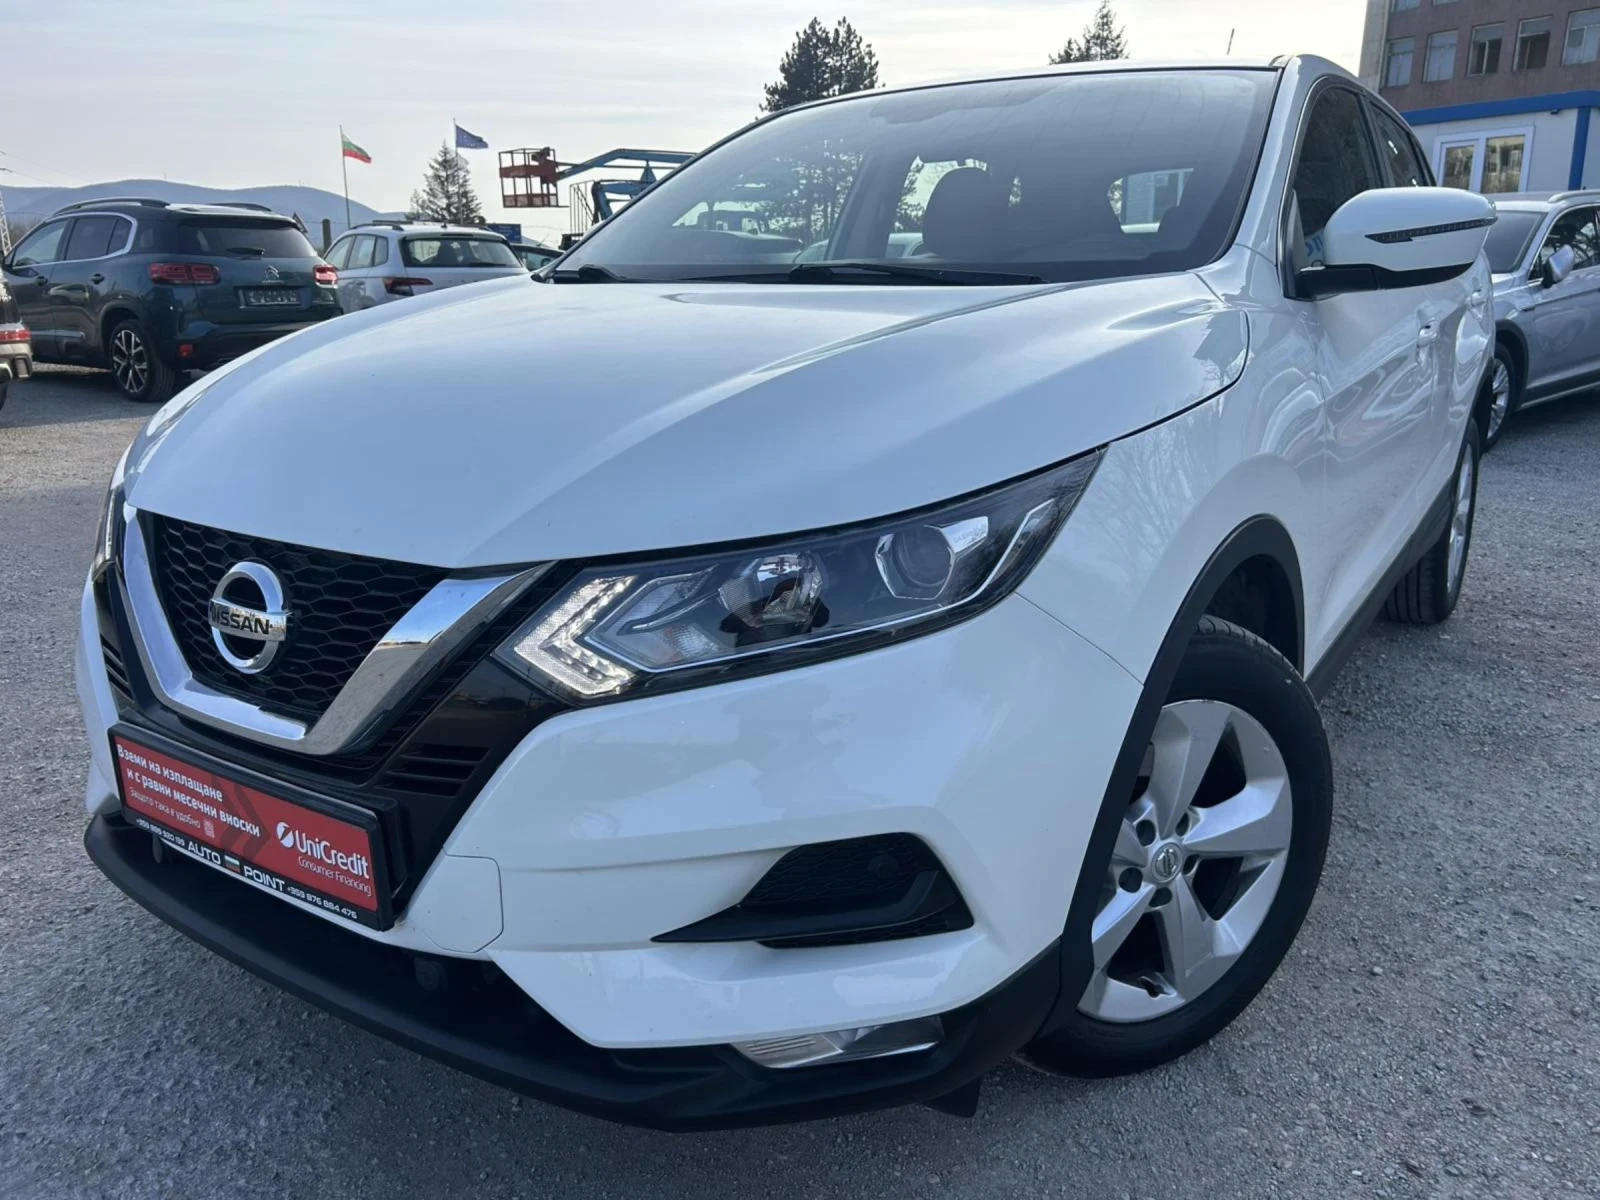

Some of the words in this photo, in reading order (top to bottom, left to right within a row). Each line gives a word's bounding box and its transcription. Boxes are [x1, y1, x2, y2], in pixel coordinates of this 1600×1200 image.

[210, 601, 270, 635] NISSAN
[116, 744, 147, 767] Вземи
[149, 760, 161, 774] на
[162, 767, 223, 802] изплащане
[127, 768, 134, 779] и
[134, 772, 141, 783] с
[142, 775, 172, 798] равни
[173, 789, 218, 819] месечни
[219, 810, 260, 837] вноски
[188, 841, 221, 865] AUTO
[295, 829, 369, 879] UniCredit
[243, 865, 285, 892] POINT
[298, 856, 335, 880] Consumer
[335, 871, 372, 897] Financing
